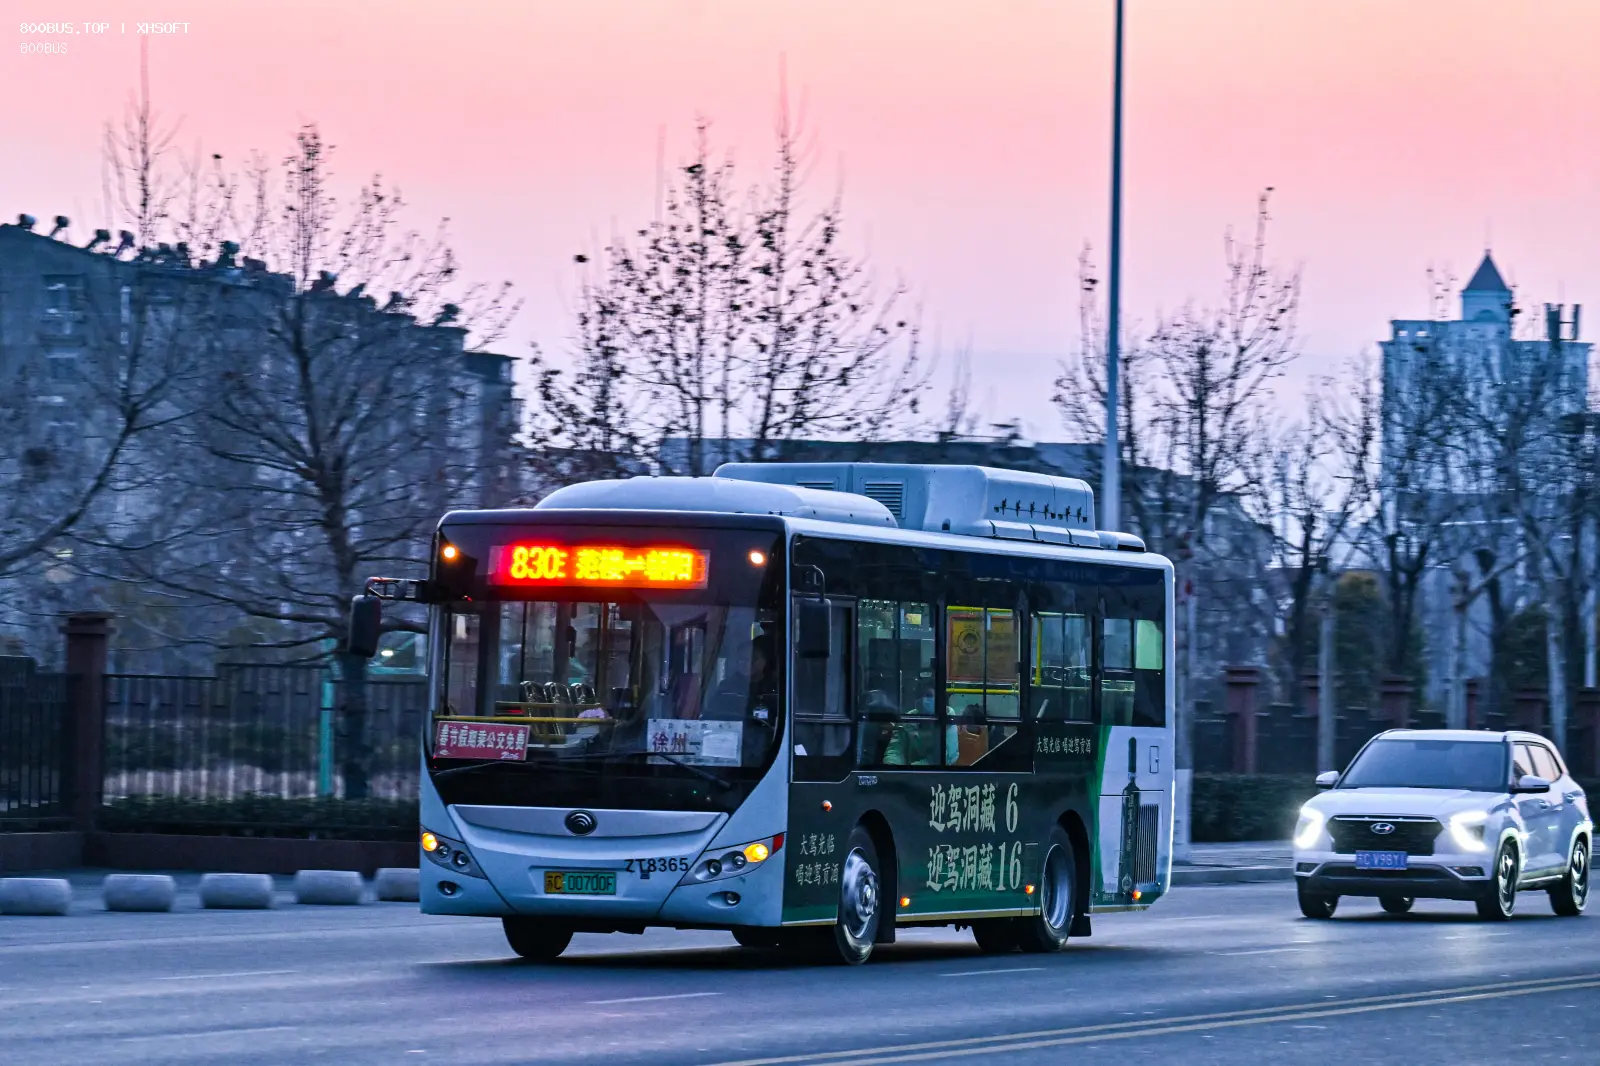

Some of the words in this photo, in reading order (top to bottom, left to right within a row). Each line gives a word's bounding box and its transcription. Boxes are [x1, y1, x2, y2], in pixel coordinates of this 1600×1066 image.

[652, 730, 688, 753] 徐州
[929, 783, 996, 833] 迎驾洞藏
[1005, 782, 1018, 833] 6
[800, 833, 835, 856] 大驾光临
[624, 857, 689, 873] ZT8365
[926, 845, 994, 892] 迎驾洞藏
[997, 841, 1022, 891] 16
